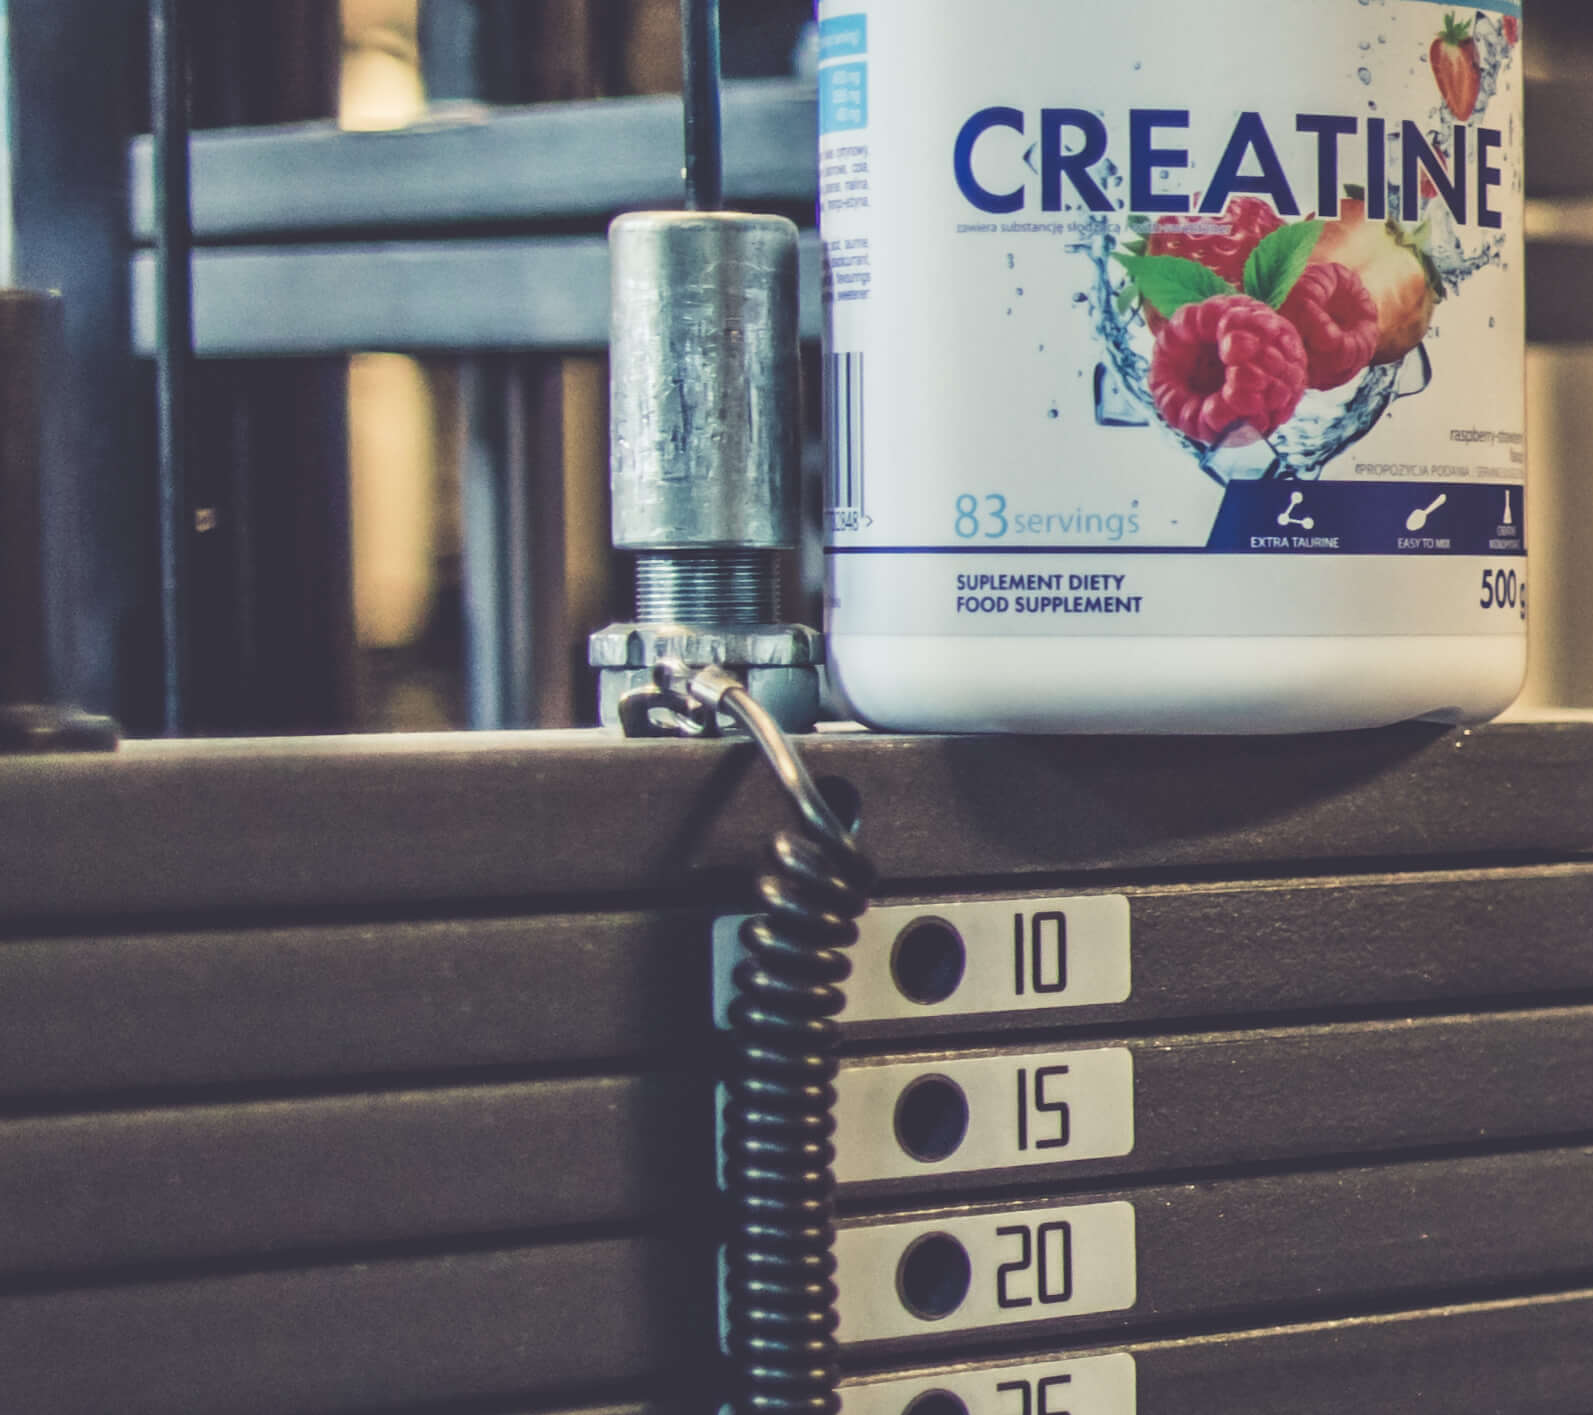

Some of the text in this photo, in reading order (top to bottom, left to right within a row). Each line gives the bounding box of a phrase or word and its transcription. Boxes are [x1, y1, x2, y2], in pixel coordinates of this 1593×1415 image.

[953, 106, 1503, 228] CREATINE
[955, 493, 1140, 541] 83 servings
[1250, 536, 1340, 549] EXTRA TAURINE
[1397, 538, 1421, 549] EASY
[1422, 538, 1434, 549] TO
[956, 574, 1126, 591] SUPLEMENT DIETY
[956, 596, 1144, 613] FOOD SUPPLEMENT
[1480, 568, 1517, 609] 500
[1014, 911, 1067, 995] 10
[1016, 1065, 1070, 1151] 15
[996, 1220, 1073, 1309] 20
